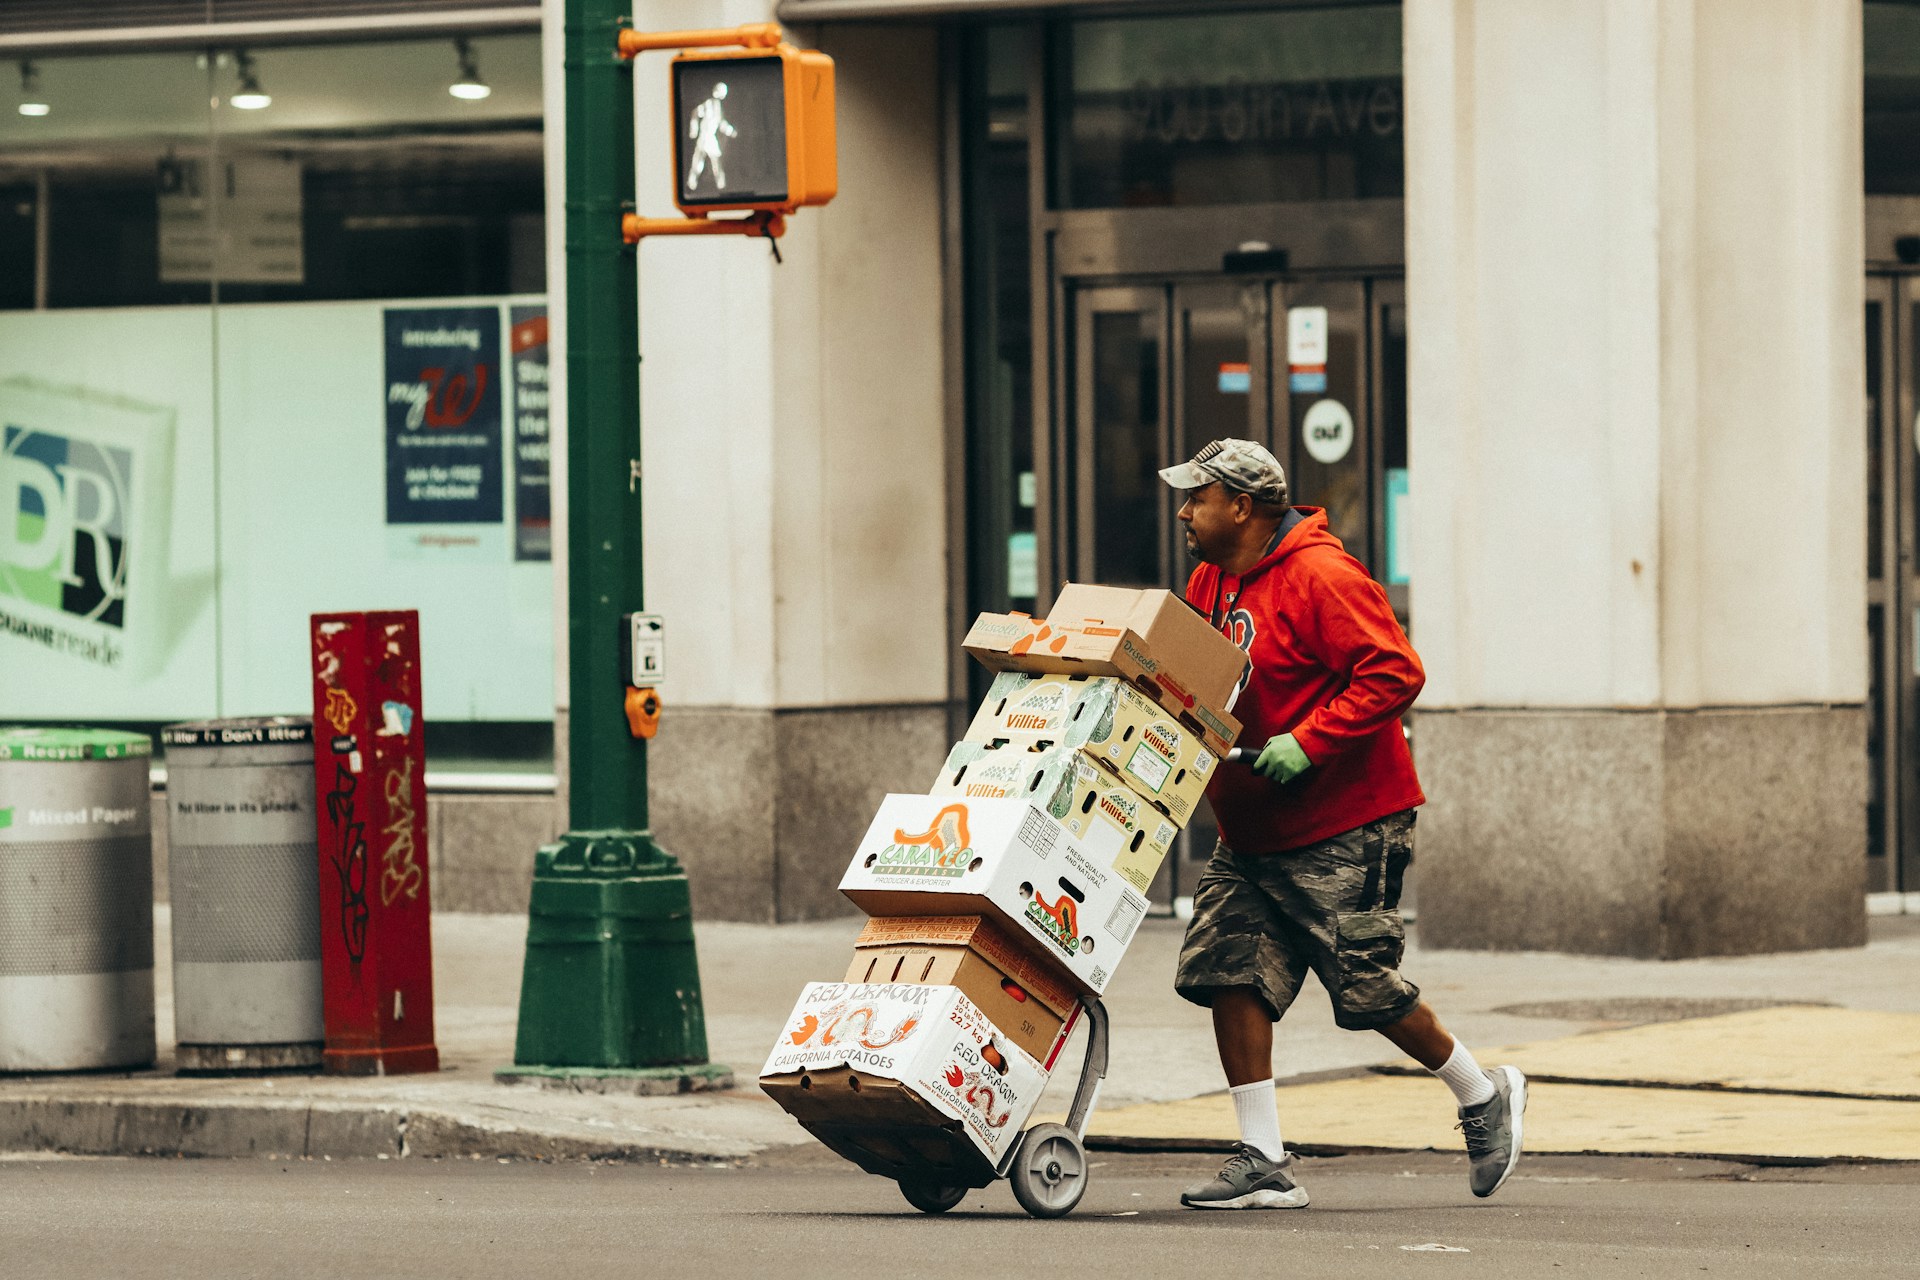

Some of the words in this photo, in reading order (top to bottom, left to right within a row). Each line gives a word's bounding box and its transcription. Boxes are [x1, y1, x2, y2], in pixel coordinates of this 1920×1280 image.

[1308, 82, 1397, 135] Ave
[402, 325, 480, 350] introducing
[222, 728, 262, 742] Don't
[269, 728, 305, 741] litter
[23, 744, 93, 760] Recycl
[29, 809, 87, 823] Mixed
[92, 807, 136, 824] Paper
[880, 844, 973, 867] CARAVEO
[1067, 846, 1084, 863] FRESH
[1085, 861, 1108, 883] QUALITY
[888, 868, 947, 876] PAPAYAS
[1065, 855, 1076, 867] AND
[1076, 865, 1101, 888] NATURAL
[1028, 901, 1079, 950] CARAVEO
[1019, 969, 1037, 988] SILK
[806, 984, 848, 1004] RED
[852, 984, 933, 1005] DRAGON
[955, 1005, 963, 1014] 50
[959, 996, 970, 1009] U.S.
[973, 1007, 983, 1022] NO.
[950, 1012, 971, 1030] 22.7
[972, 1028, 983, 1044] kg
[1021, 1020, 1036, 1038] 5X6
[774, 1052, 830, 1067] CALIFORNIA
[834, 1050, 895, 1069] POTATOES
[953, 1042, 980, 1066] RED
[981, 1064, 1018, 1106] DRAGON
[932, 1081, 970, 1115] CALIFORNIA
[970, 1112, 995, 1143] POTATOES
